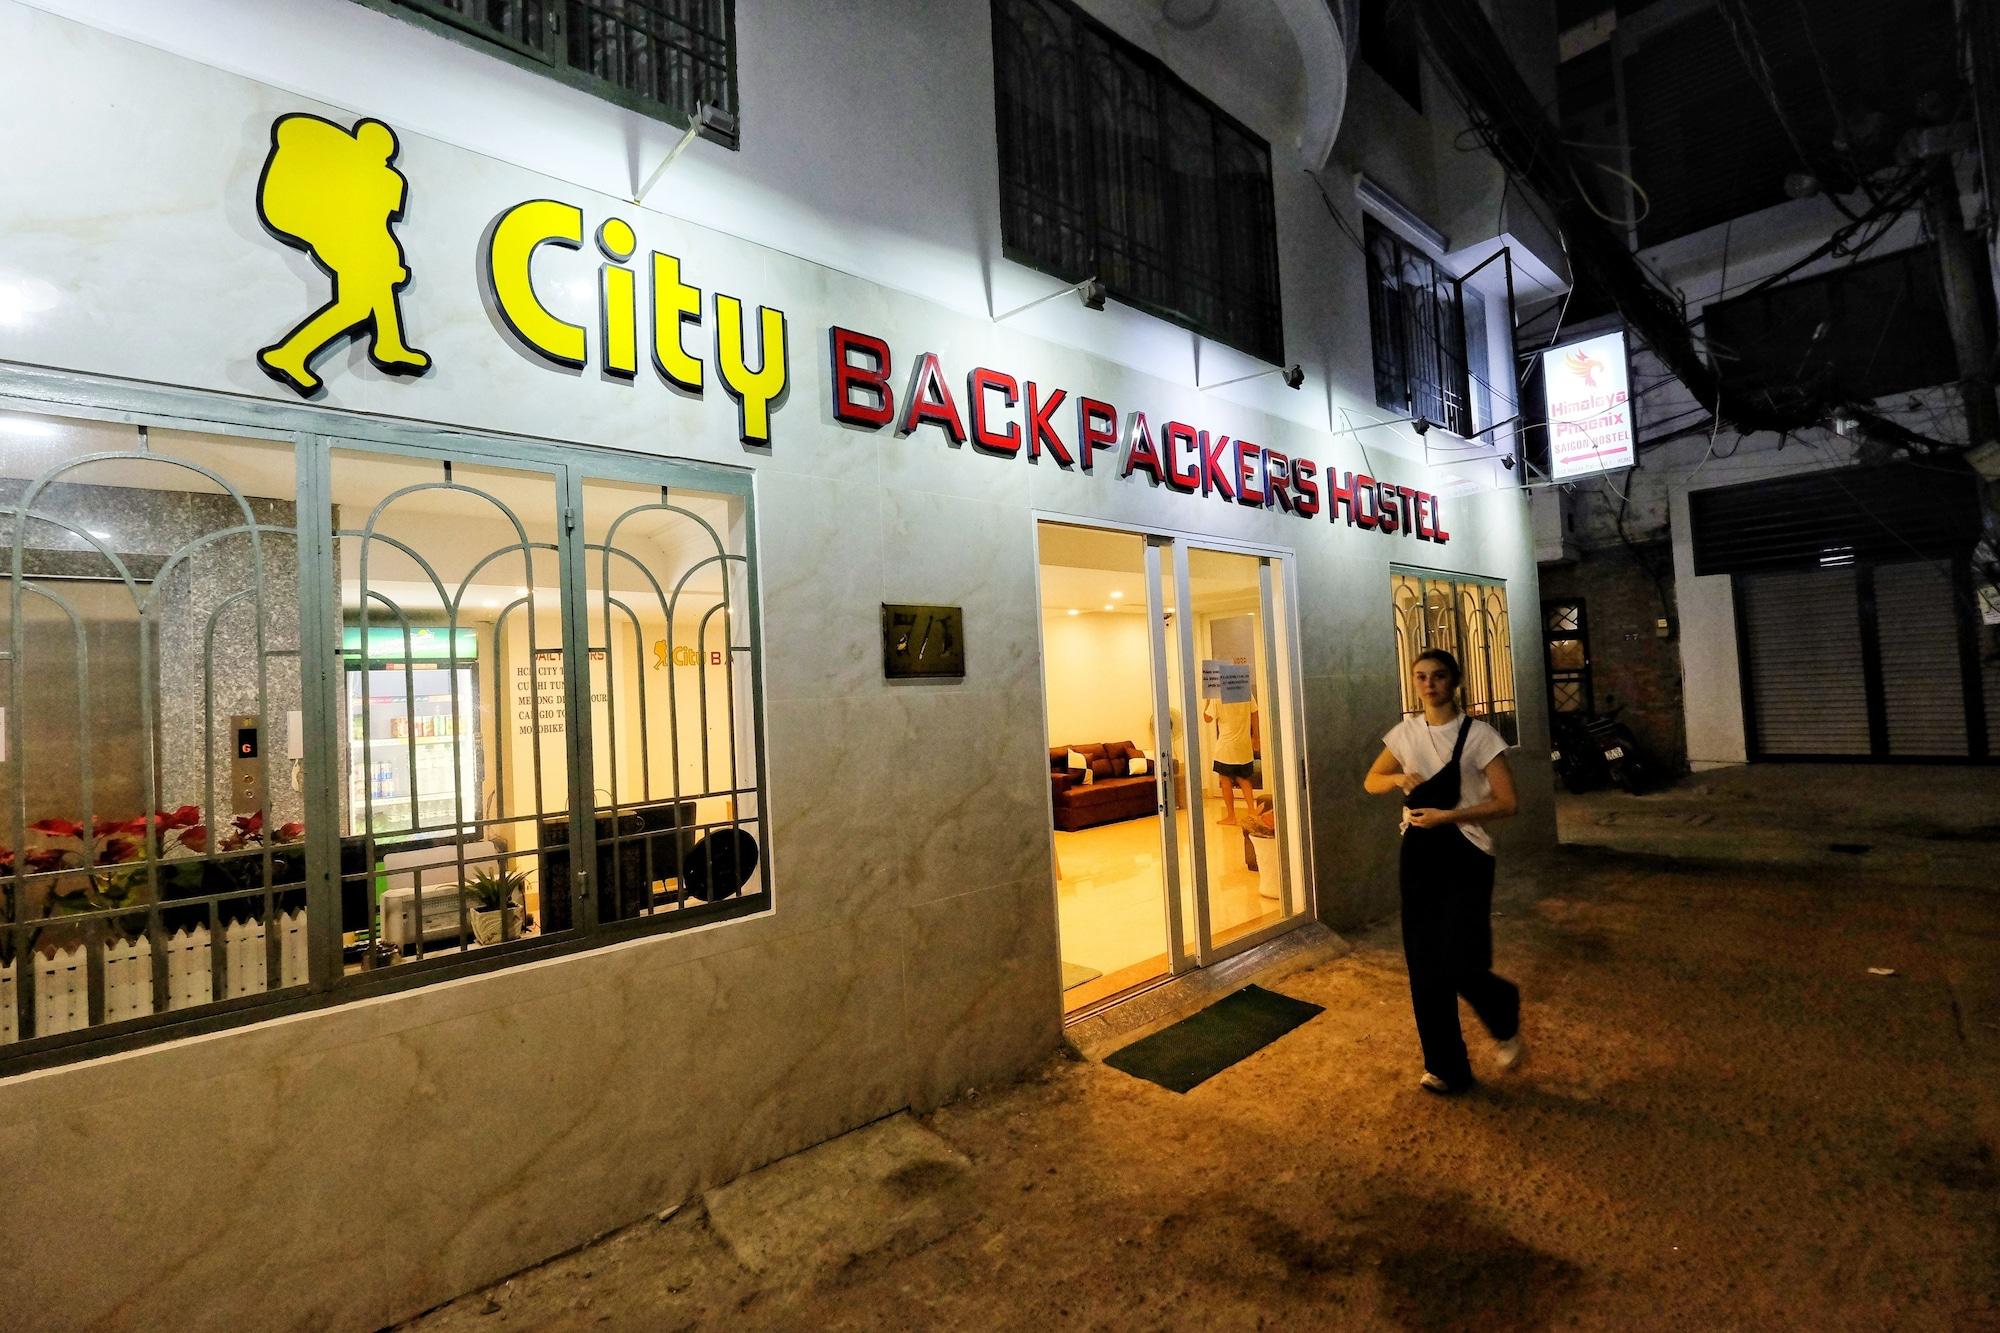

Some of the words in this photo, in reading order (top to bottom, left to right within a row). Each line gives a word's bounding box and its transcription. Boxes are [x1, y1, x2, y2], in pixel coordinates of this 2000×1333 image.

[487, 198, 787, 446] City
[829, 326, 1320, 519] BACKPACKERS
[1326, 466, 1450, 544] HOSTEL
[1552, 391, 1626, 417] Himalaya
[1557, 412, 1623, 437] Phoenix
[1554, 439, 1589, 454] SAIGON
[1592, 430, 1631, 446] HOSTEL
[517, 667, 531, 676] HC
[538, 667, 558, 676] CITY
[518, 695, 554, 705] MEONG
[591, 694, 608, 703] OUR
[518, 711, 534, 720] CA
[519, 723, 564, 735] MOOBIKE
